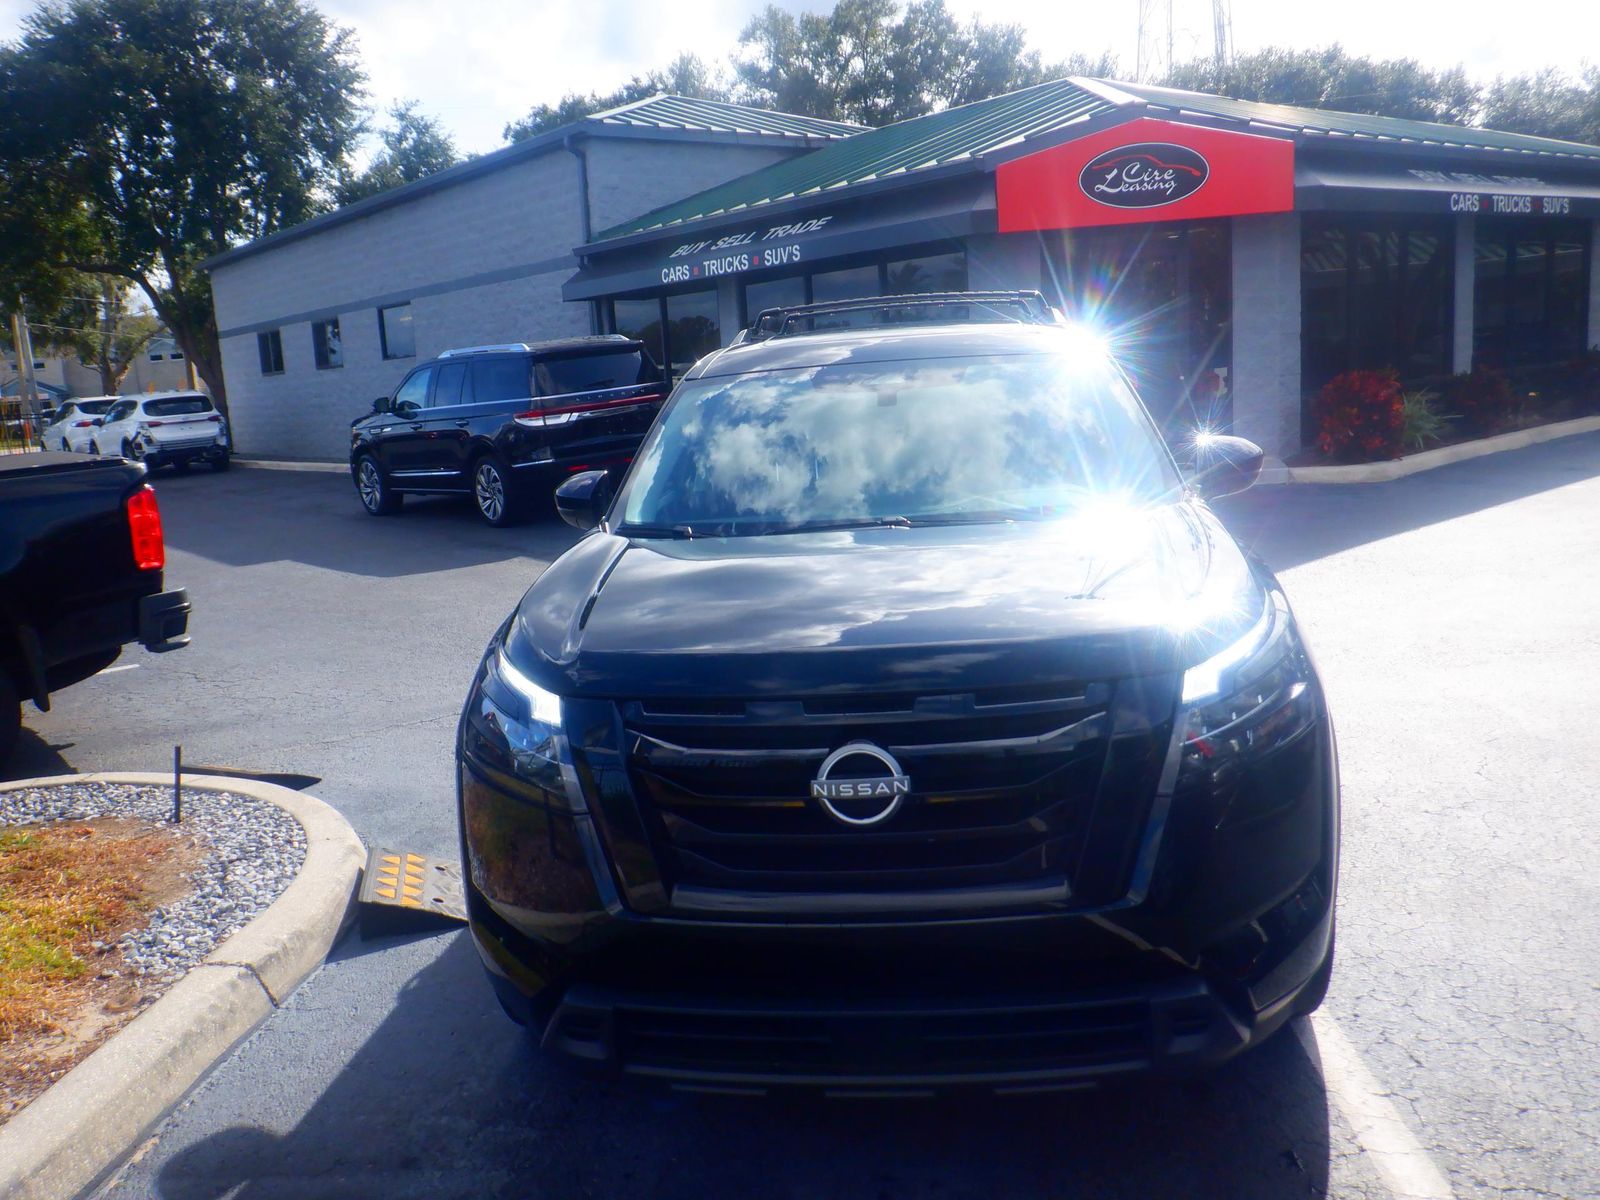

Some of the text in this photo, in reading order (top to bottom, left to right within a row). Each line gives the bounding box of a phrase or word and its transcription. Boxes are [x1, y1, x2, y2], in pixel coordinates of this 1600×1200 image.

[1094, 168, 1178, 195] Leasing
[1122, 161, 1176, 183] Cire
[1450, 193, 1570, 214] CARS TRUCKS SUV'S
[669, 216, 833, 258] BUY SELL TRADE
[661, 245, 801, 284] CARS TRUCKS SUV'S
[813, 779, 909, 797] NISSAN
